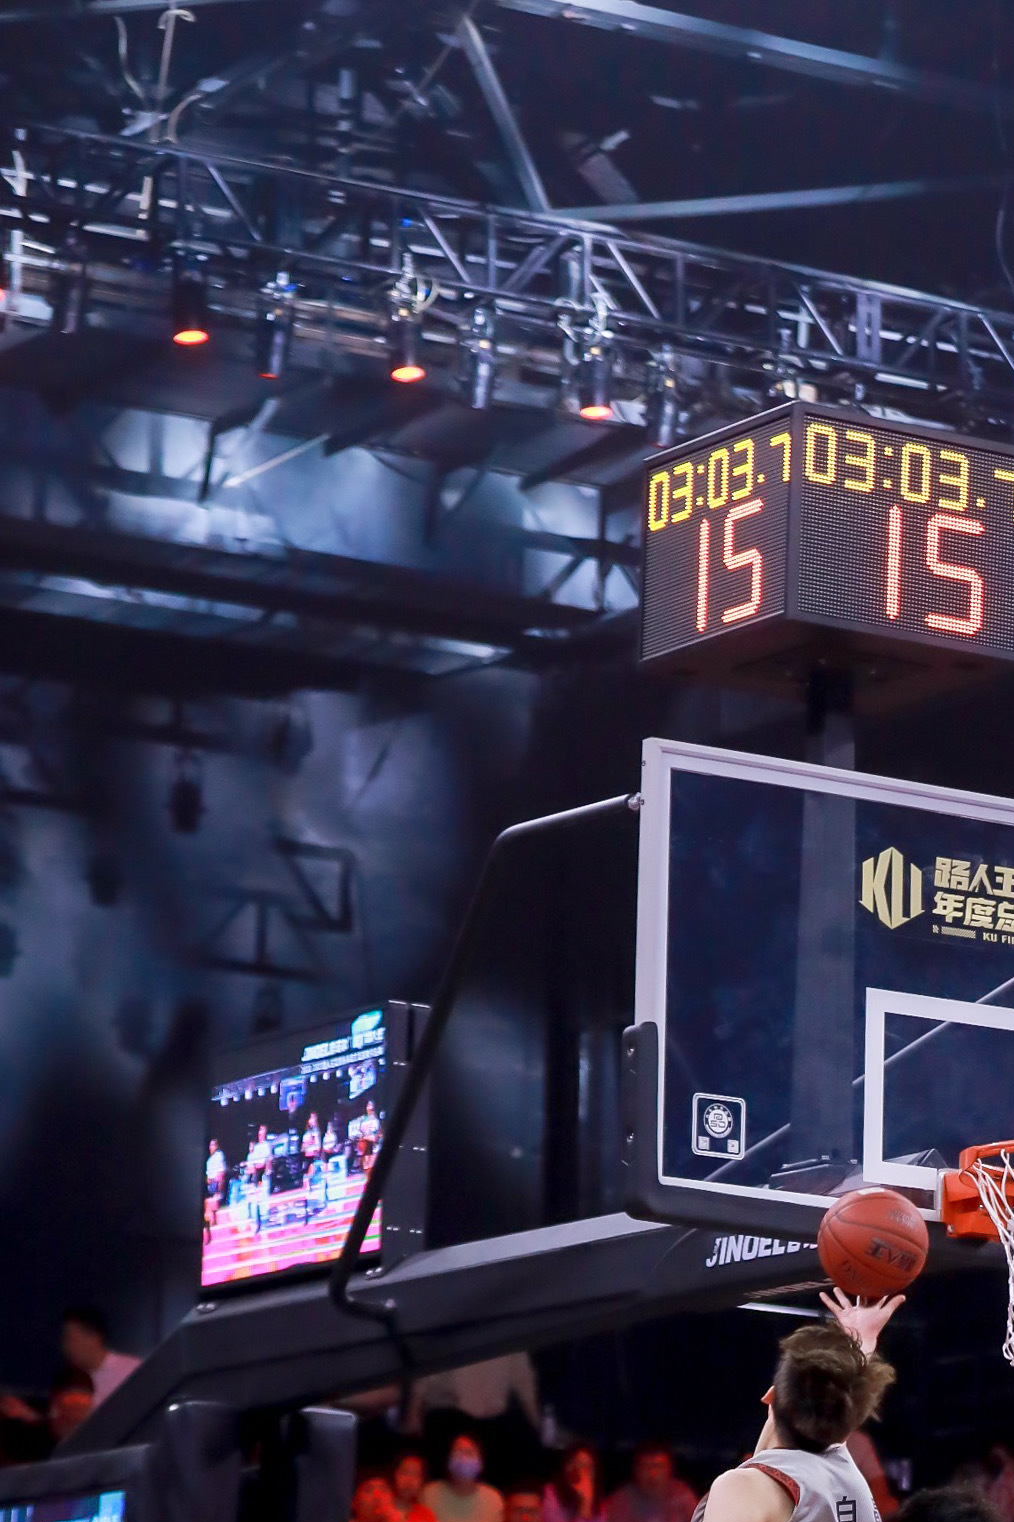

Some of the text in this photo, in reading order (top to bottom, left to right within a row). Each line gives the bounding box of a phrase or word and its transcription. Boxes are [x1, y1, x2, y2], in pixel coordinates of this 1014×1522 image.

[696, 499, 763, 633] 15
[886, 505, 985, 635] 15
[983, 932, 998, 943] KU
